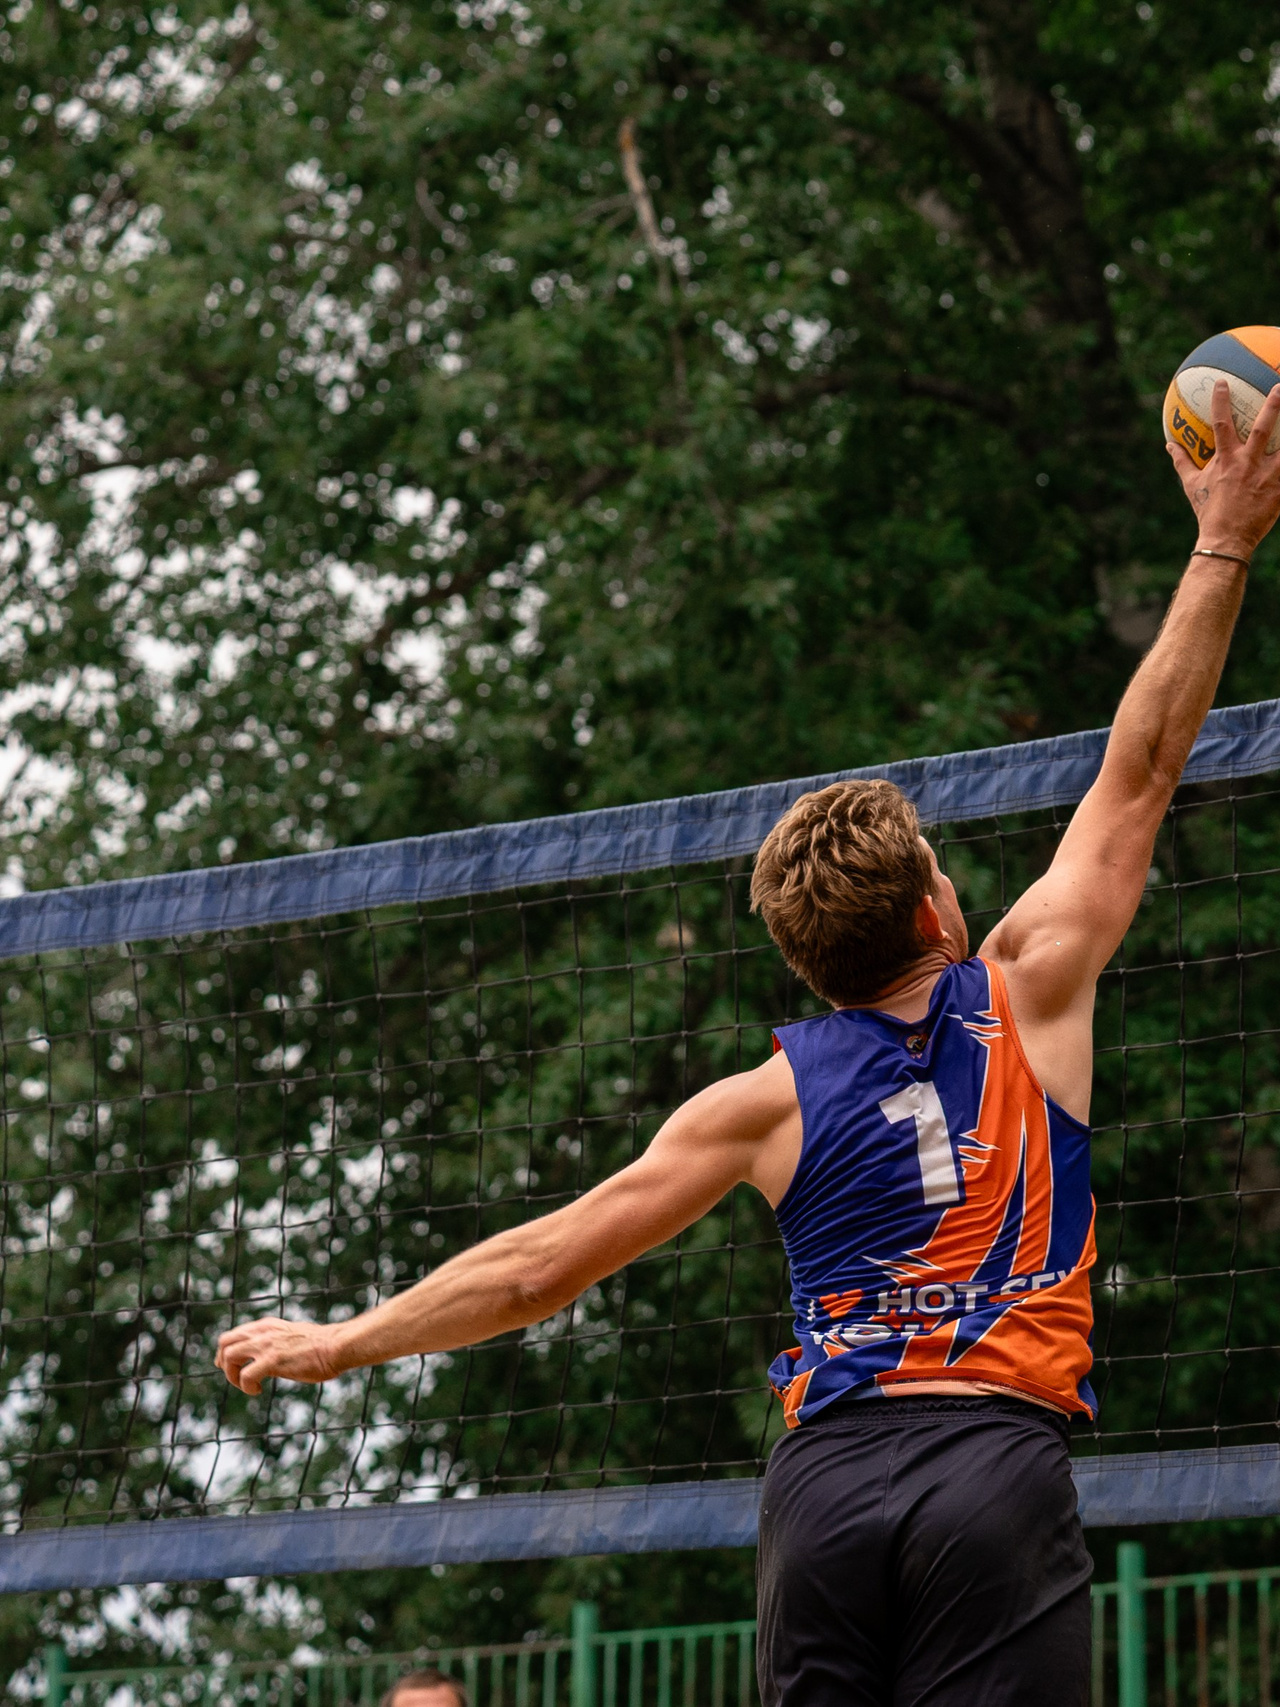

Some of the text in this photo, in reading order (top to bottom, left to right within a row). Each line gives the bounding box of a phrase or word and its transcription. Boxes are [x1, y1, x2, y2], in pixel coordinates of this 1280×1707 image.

[1173, 408, 1216, 461] ASA
[878, 1080, 960, 1205] 1
[876, 1283, 988, 1314] HOT
